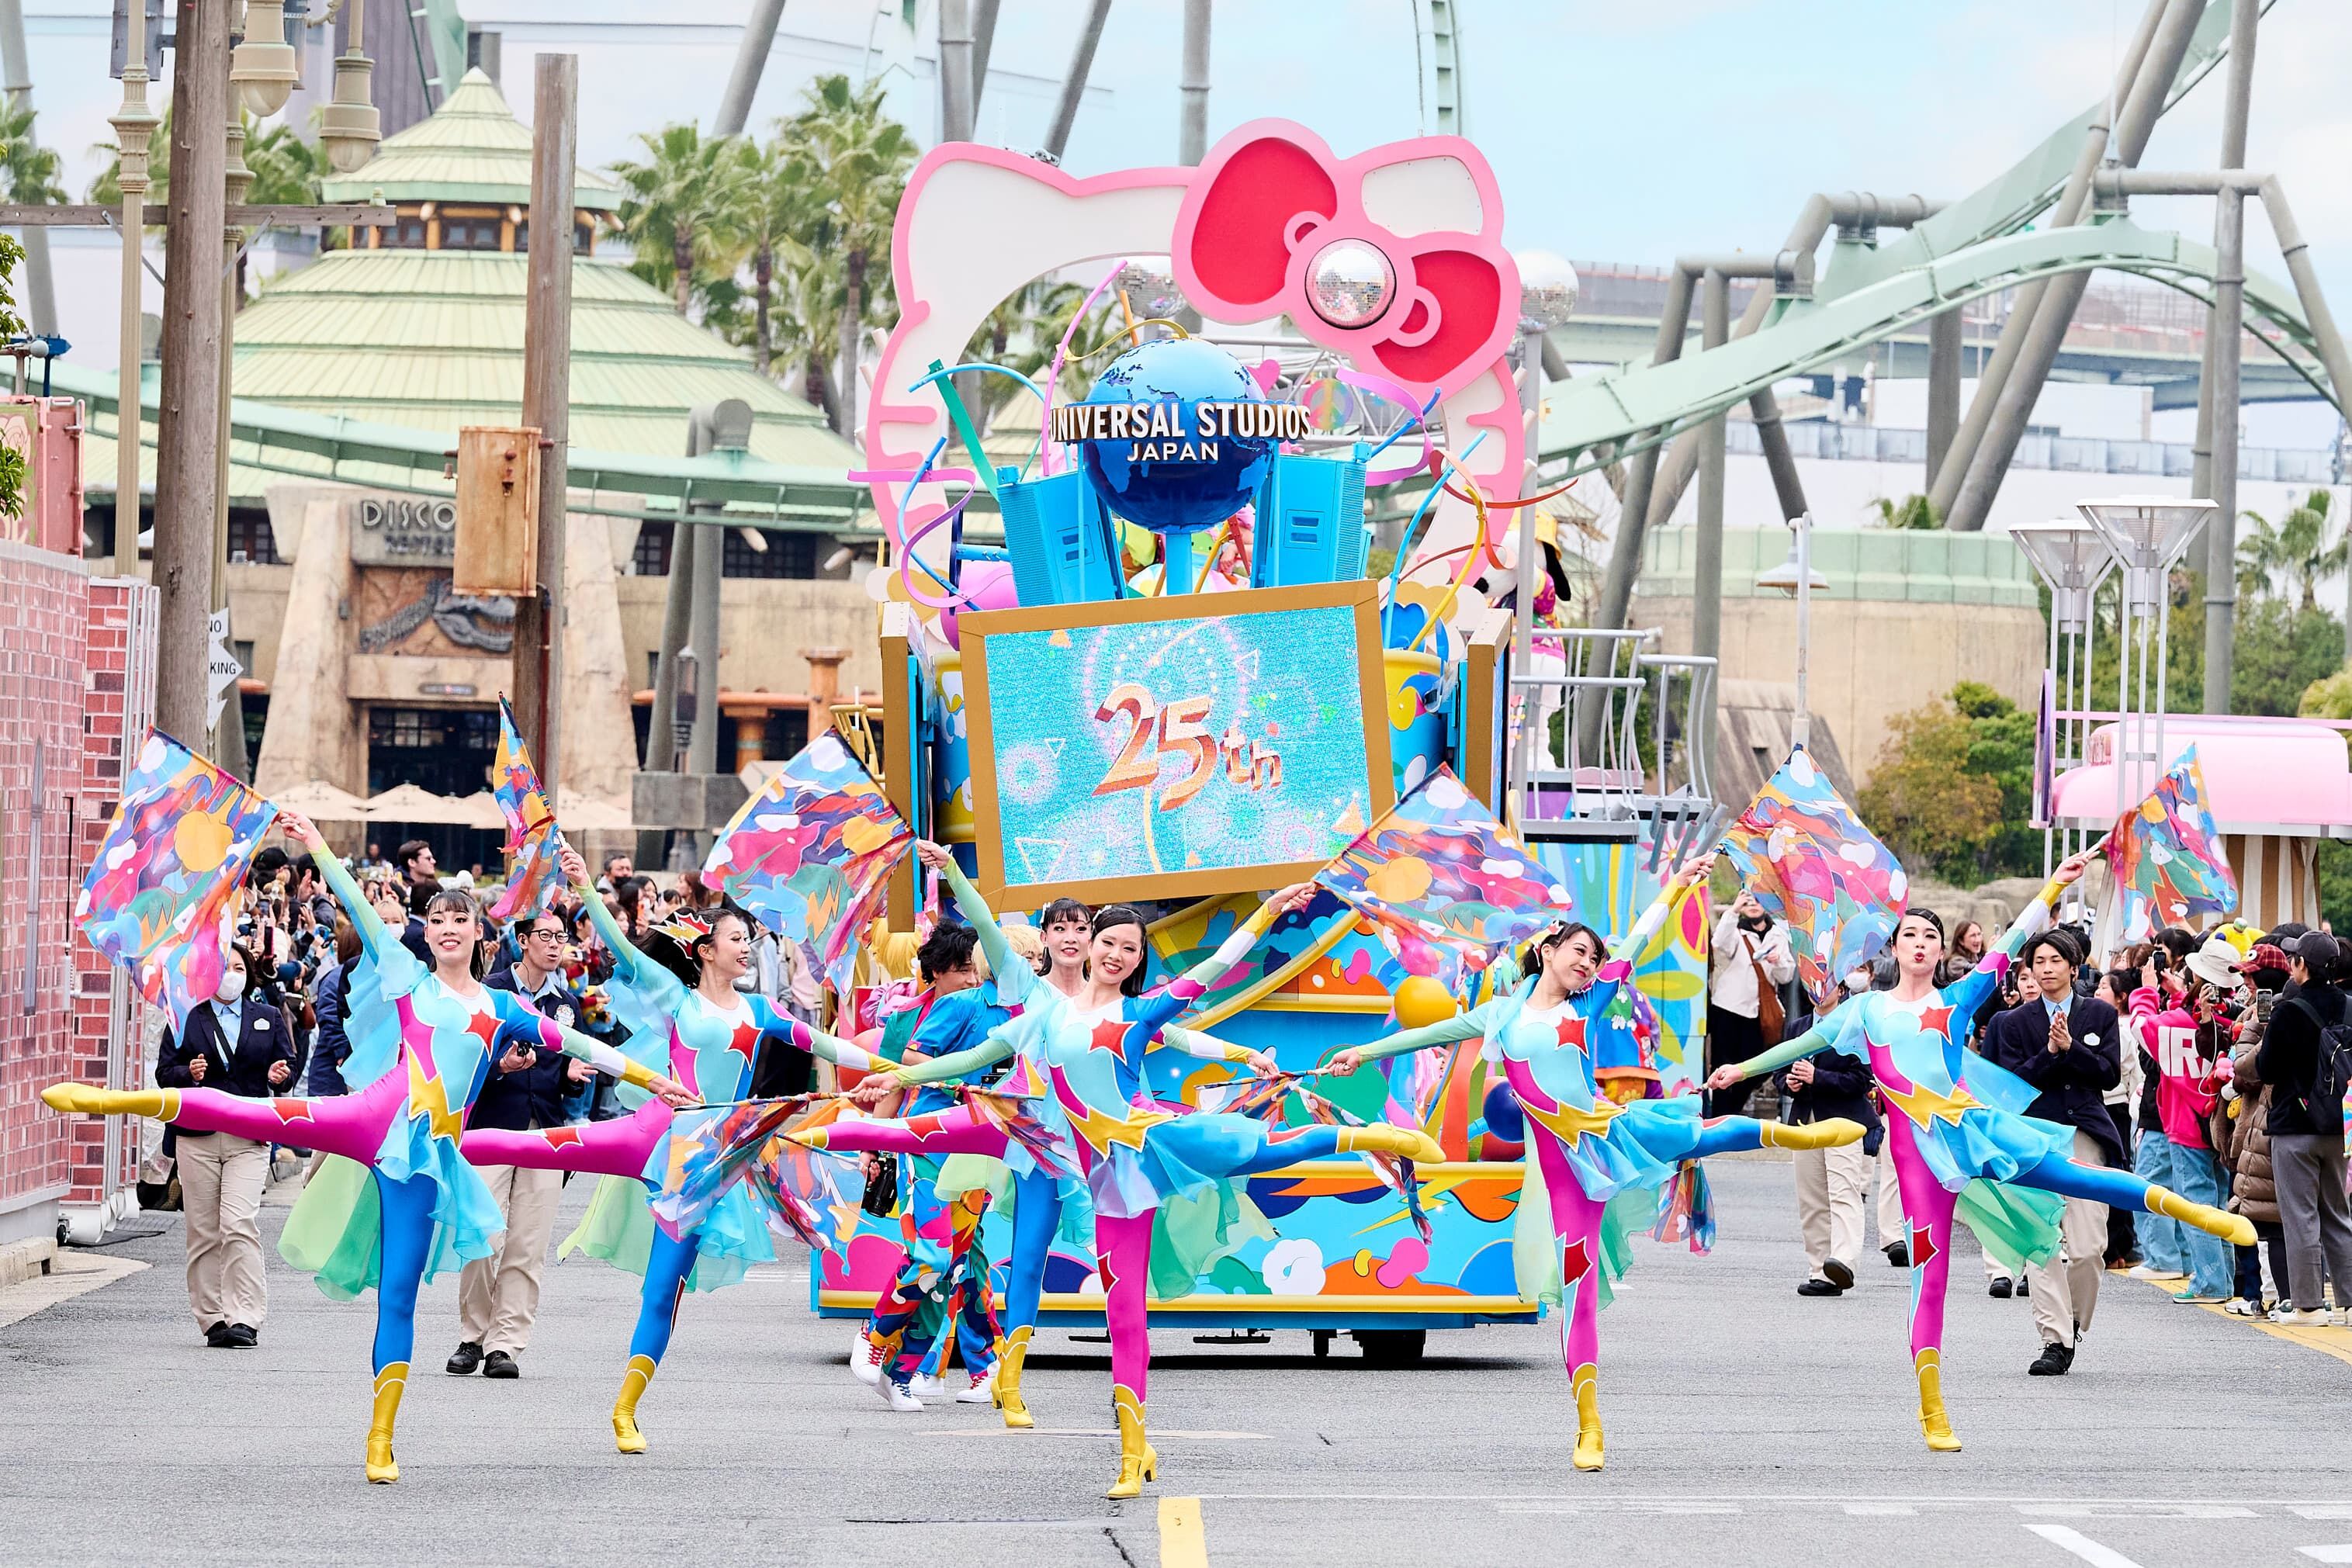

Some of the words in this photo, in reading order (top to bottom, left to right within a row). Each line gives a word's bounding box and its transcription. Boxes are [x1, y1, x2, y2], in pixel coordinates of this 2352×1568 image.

[1050, 403, 1186, 442] UNIVERSAL
[1197, 403, 1311, 440] STUDIOS
[1127, 441, 1219, 462] JAPAN
[1092, 683, 1282, 812] 25th
